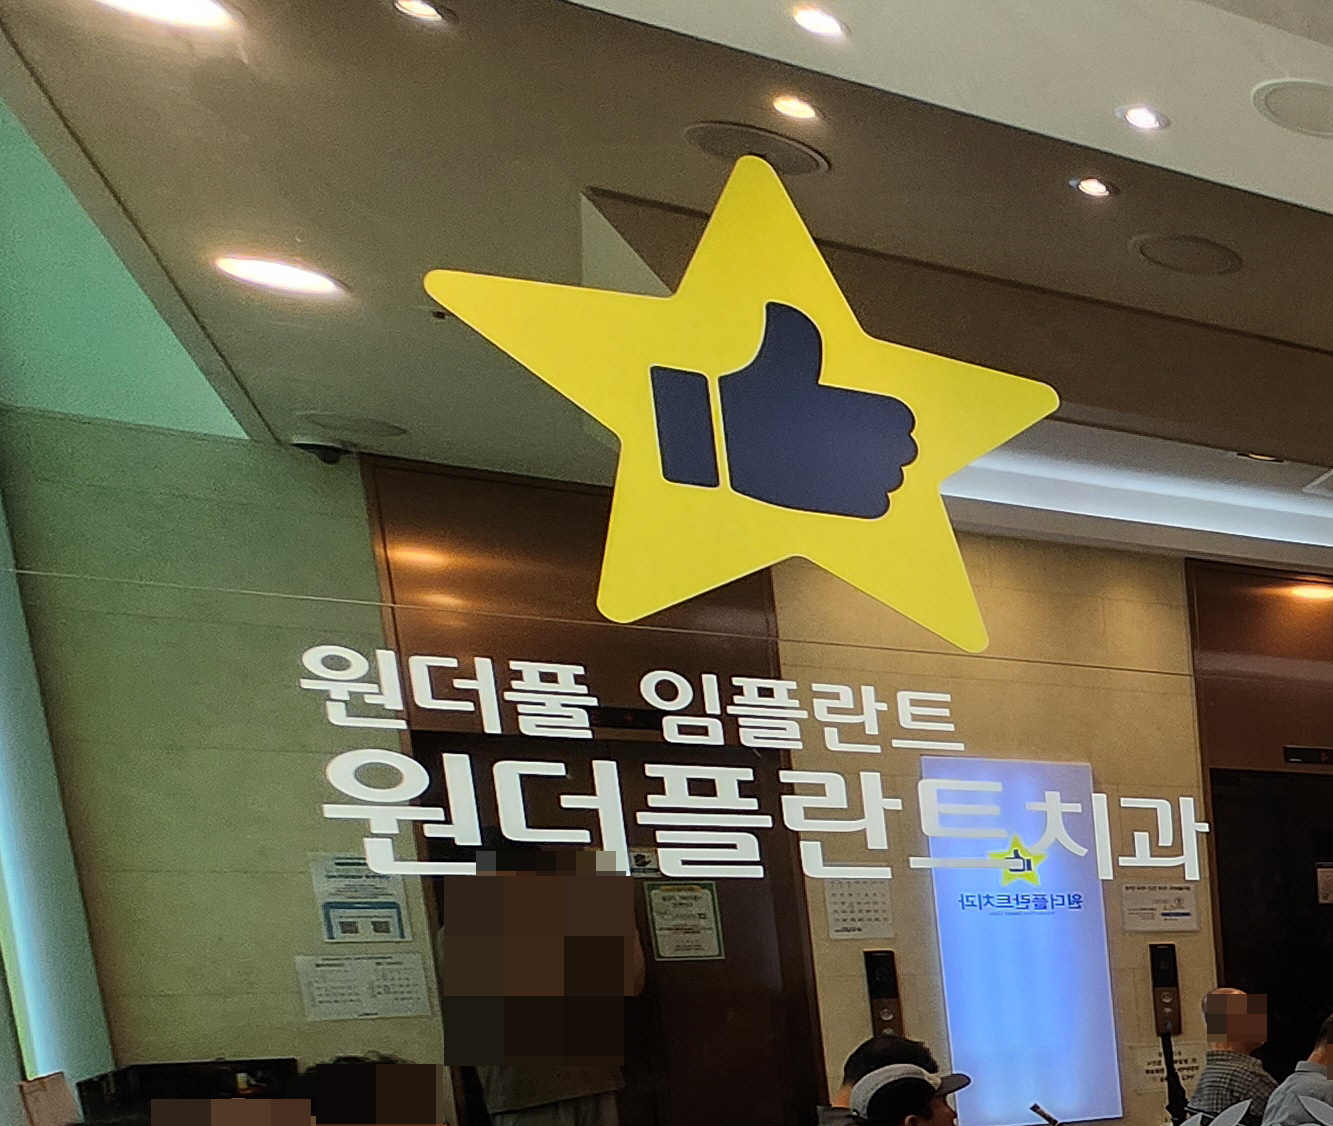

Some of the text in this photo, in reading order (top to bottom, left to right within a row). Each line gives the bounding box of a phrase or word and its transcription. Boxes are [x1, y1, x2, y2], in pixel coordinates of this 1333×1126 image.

[298, 644, 966, 753] 원더풀 임플란트
[321, 747, 1210, 882] 원더플란트치과
